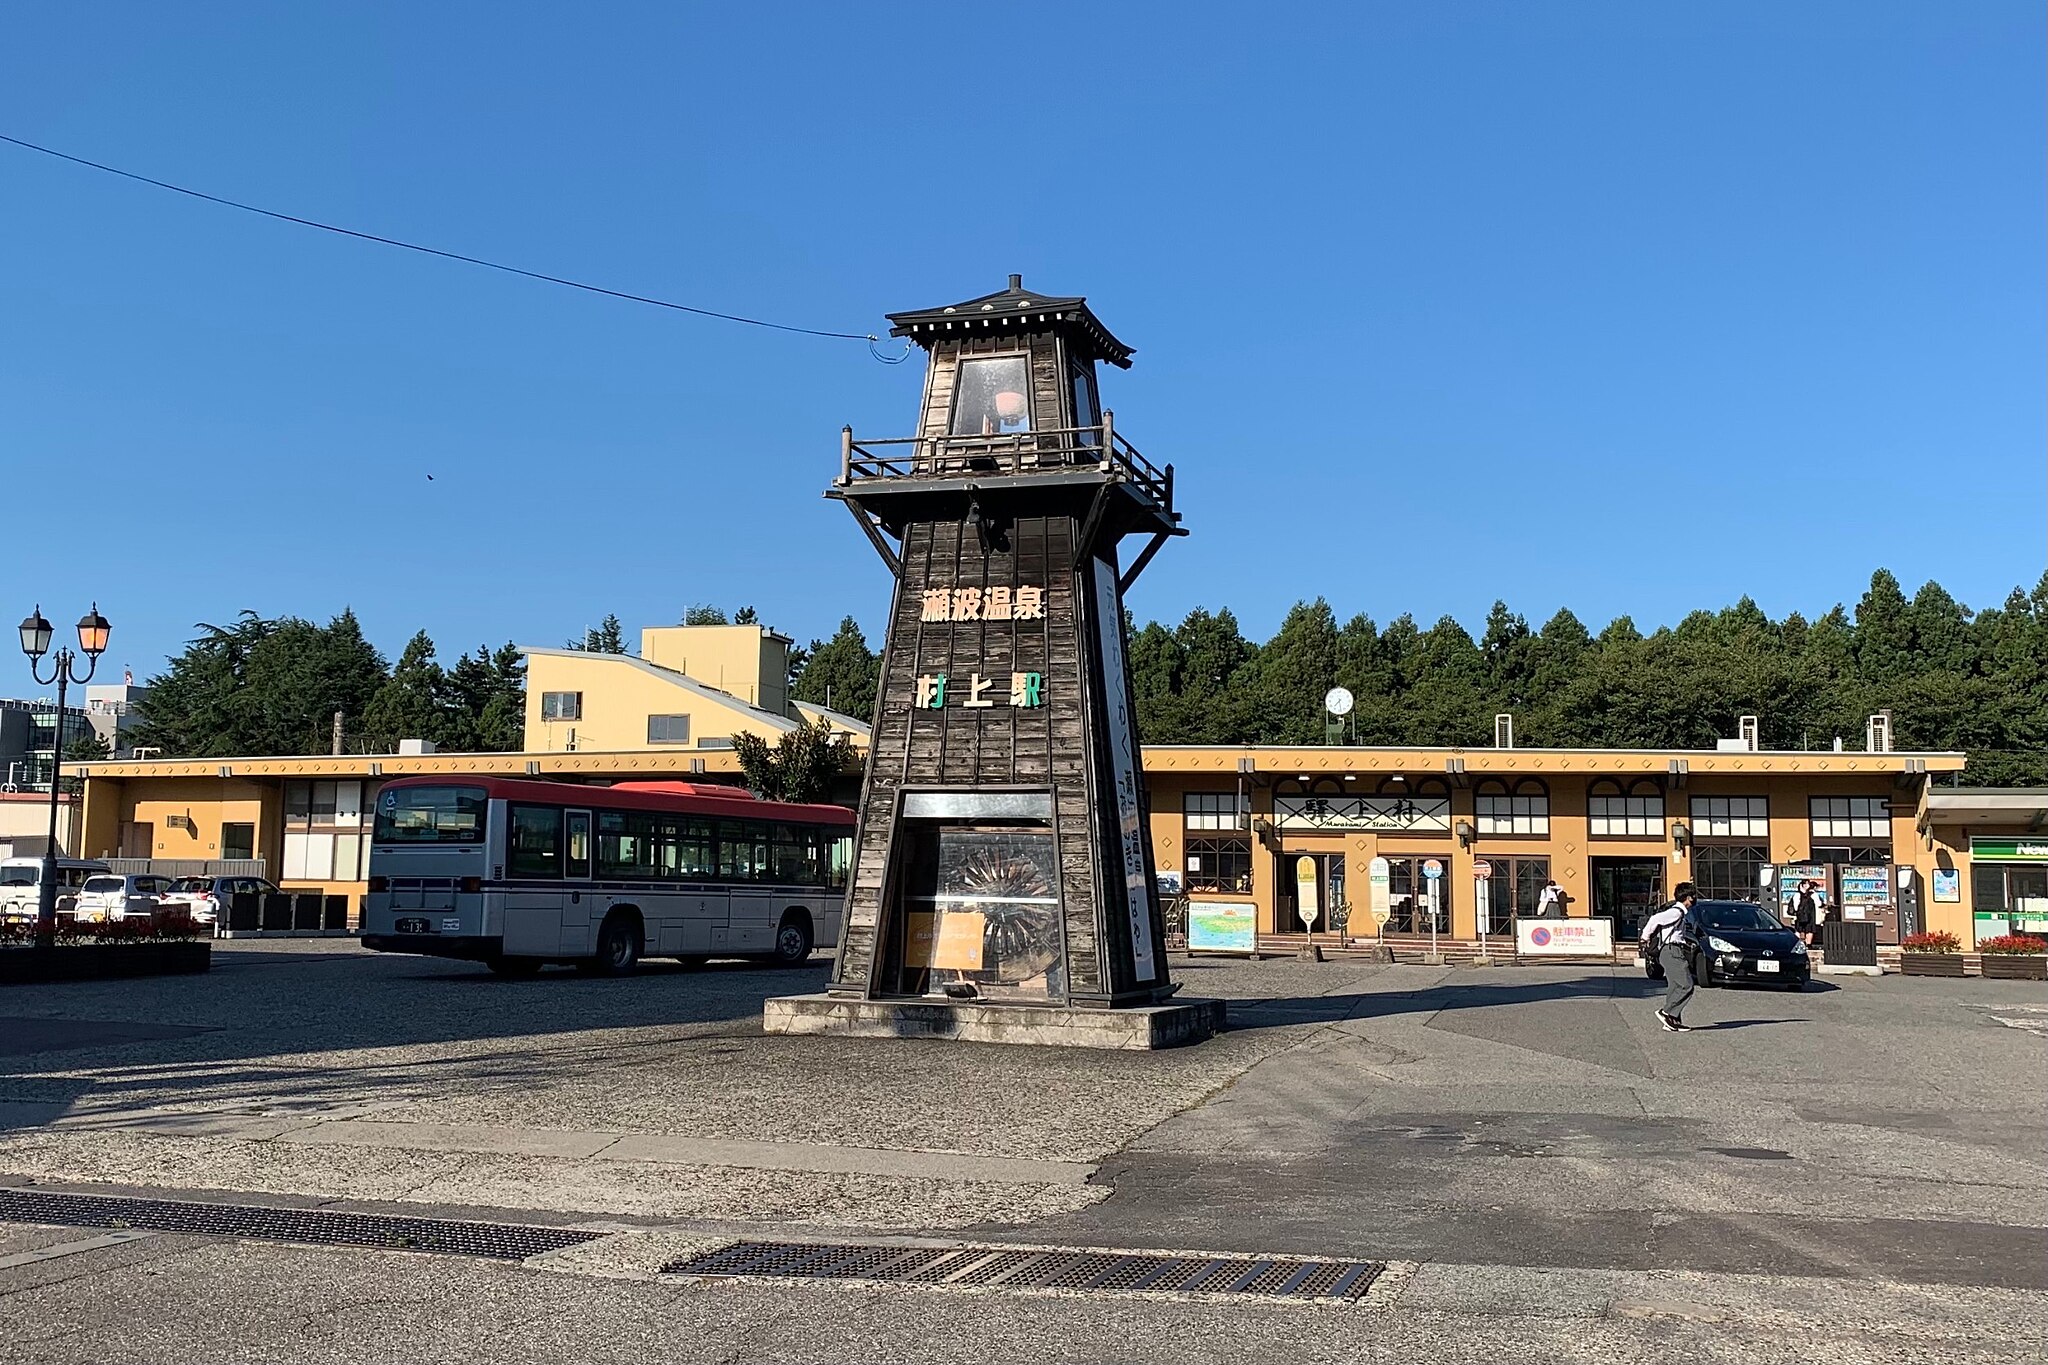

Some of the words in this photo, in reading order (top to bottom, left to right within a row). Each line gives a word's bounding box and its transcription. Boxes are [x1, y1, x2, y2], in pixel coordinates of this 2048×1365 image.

[915, 672, 1041, 709] 村上駅
[1325, 820, 1362, 828] Murakami
[1552, 926, 1596, 937] 駐車禁止
